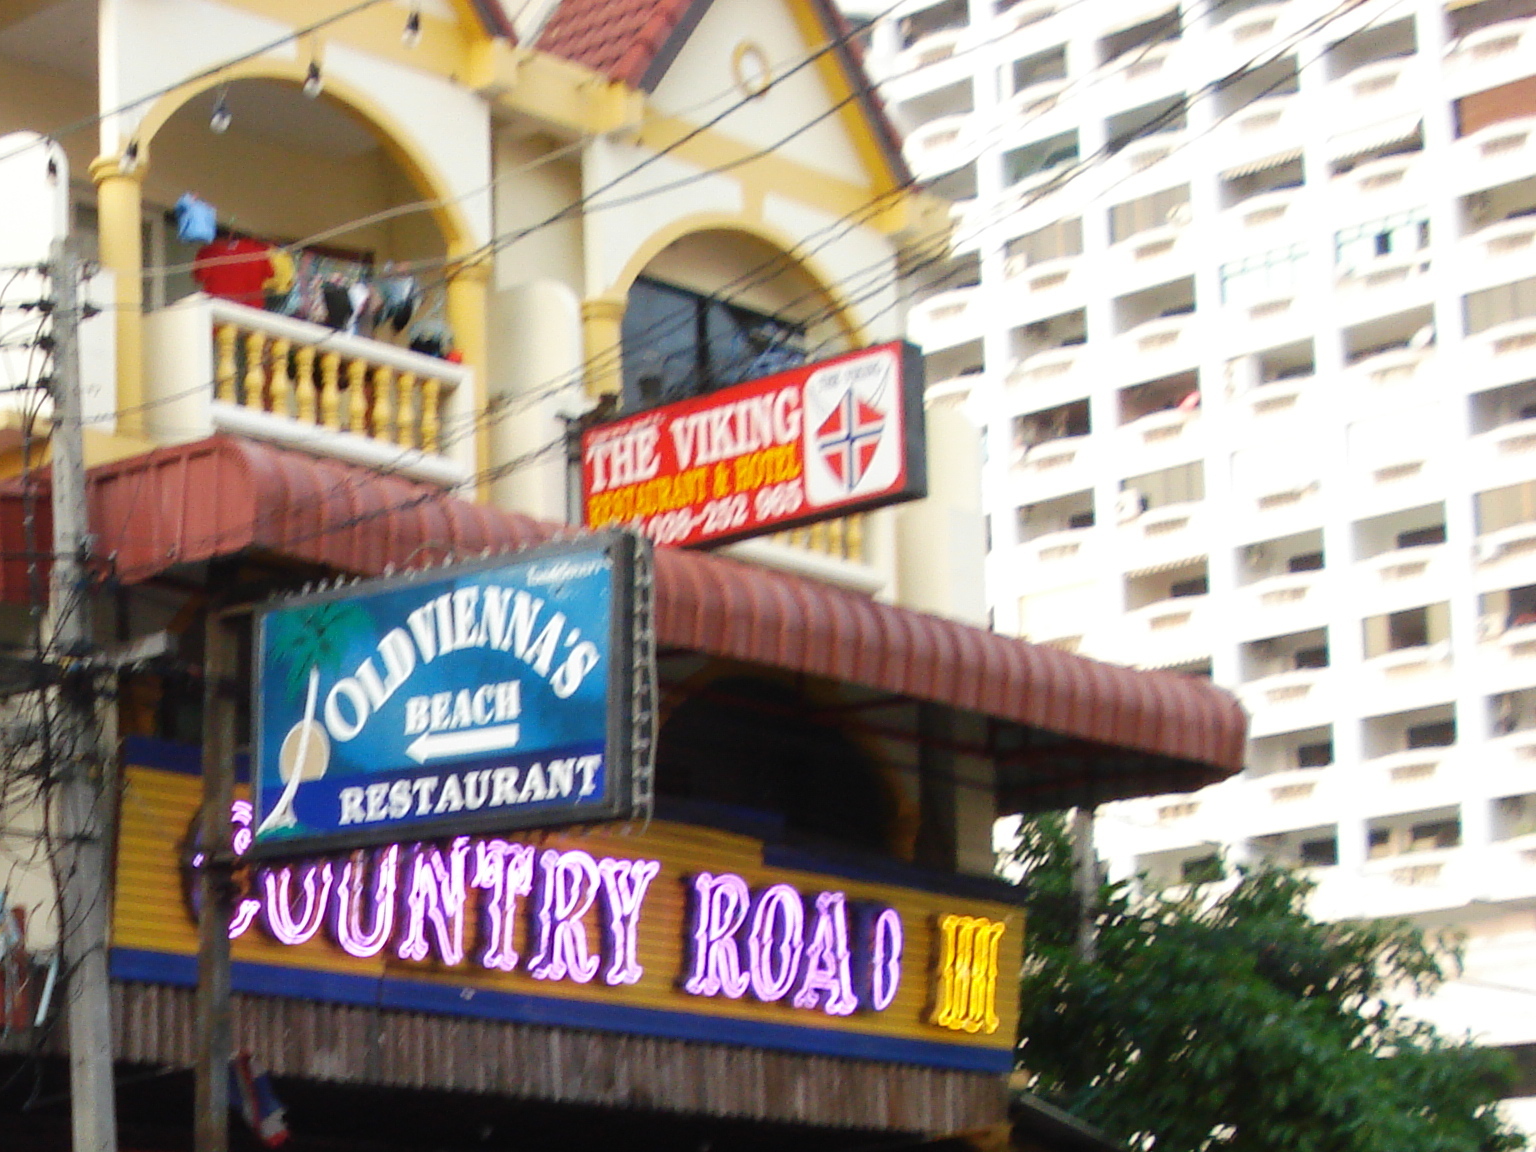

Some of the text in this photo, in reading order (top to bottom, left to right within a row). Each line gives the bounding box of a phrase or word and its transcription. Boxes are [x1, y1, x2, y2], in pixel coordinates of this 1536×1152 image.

[585, 424, 662, 495] THE
[668, 385, 803, 472] VIKING
[732, 441, 803, 492] HOTEL
[404, 680, 522, 736] BEACH
[338, 753, 603, 826] RESTAURANT
